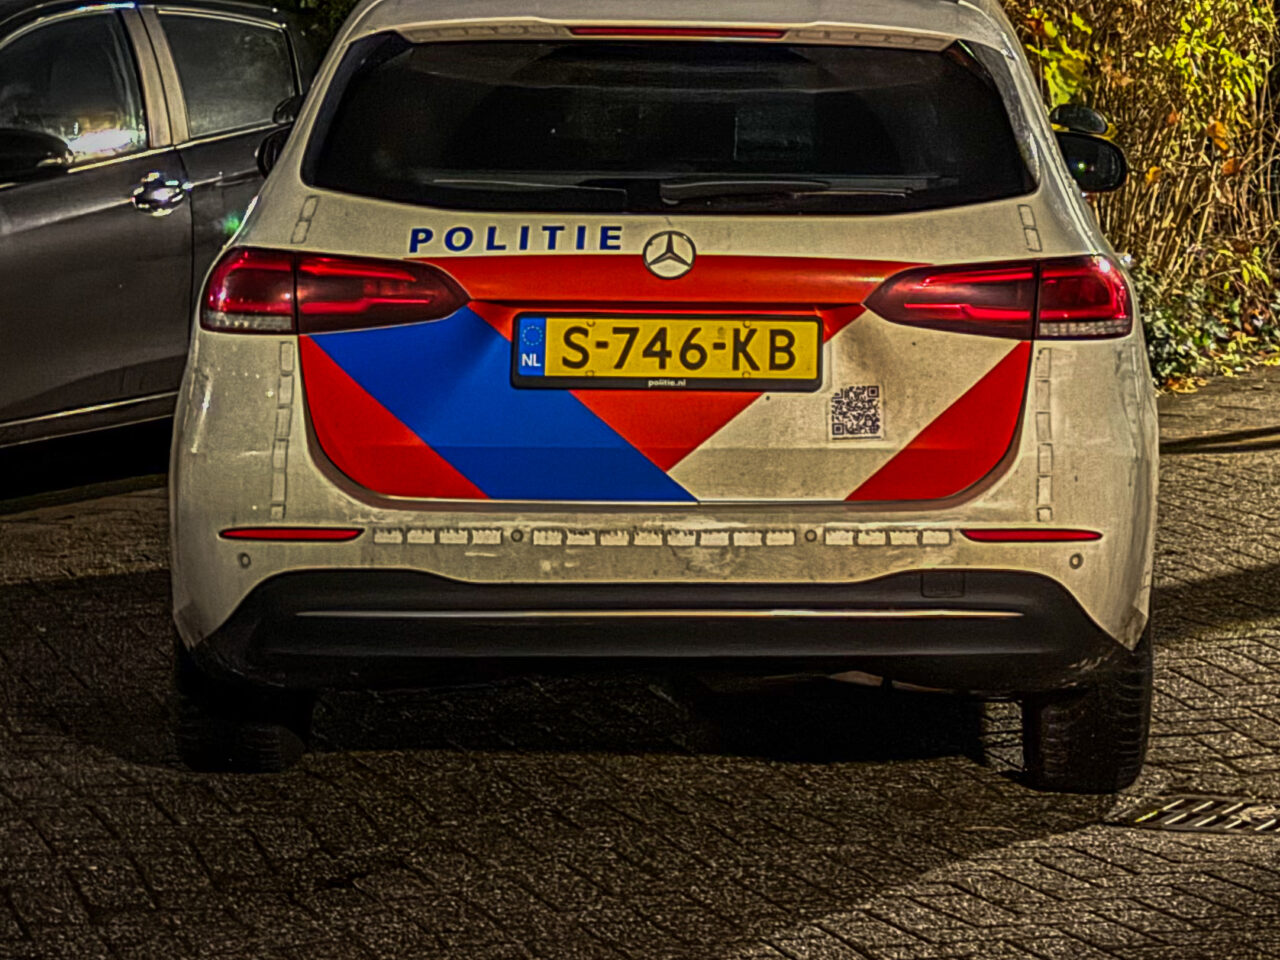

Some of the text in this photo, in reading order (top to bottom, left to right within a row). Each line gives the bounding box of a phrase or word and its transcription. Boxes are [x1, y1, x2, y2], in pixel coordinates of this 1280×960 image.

[409, 225, 623, 253] POLITIE
[561, 326, 796, 372] S-746-KB
[521, 353, 541, 367] NL
[648, 379, 686, 388] politie.nl
